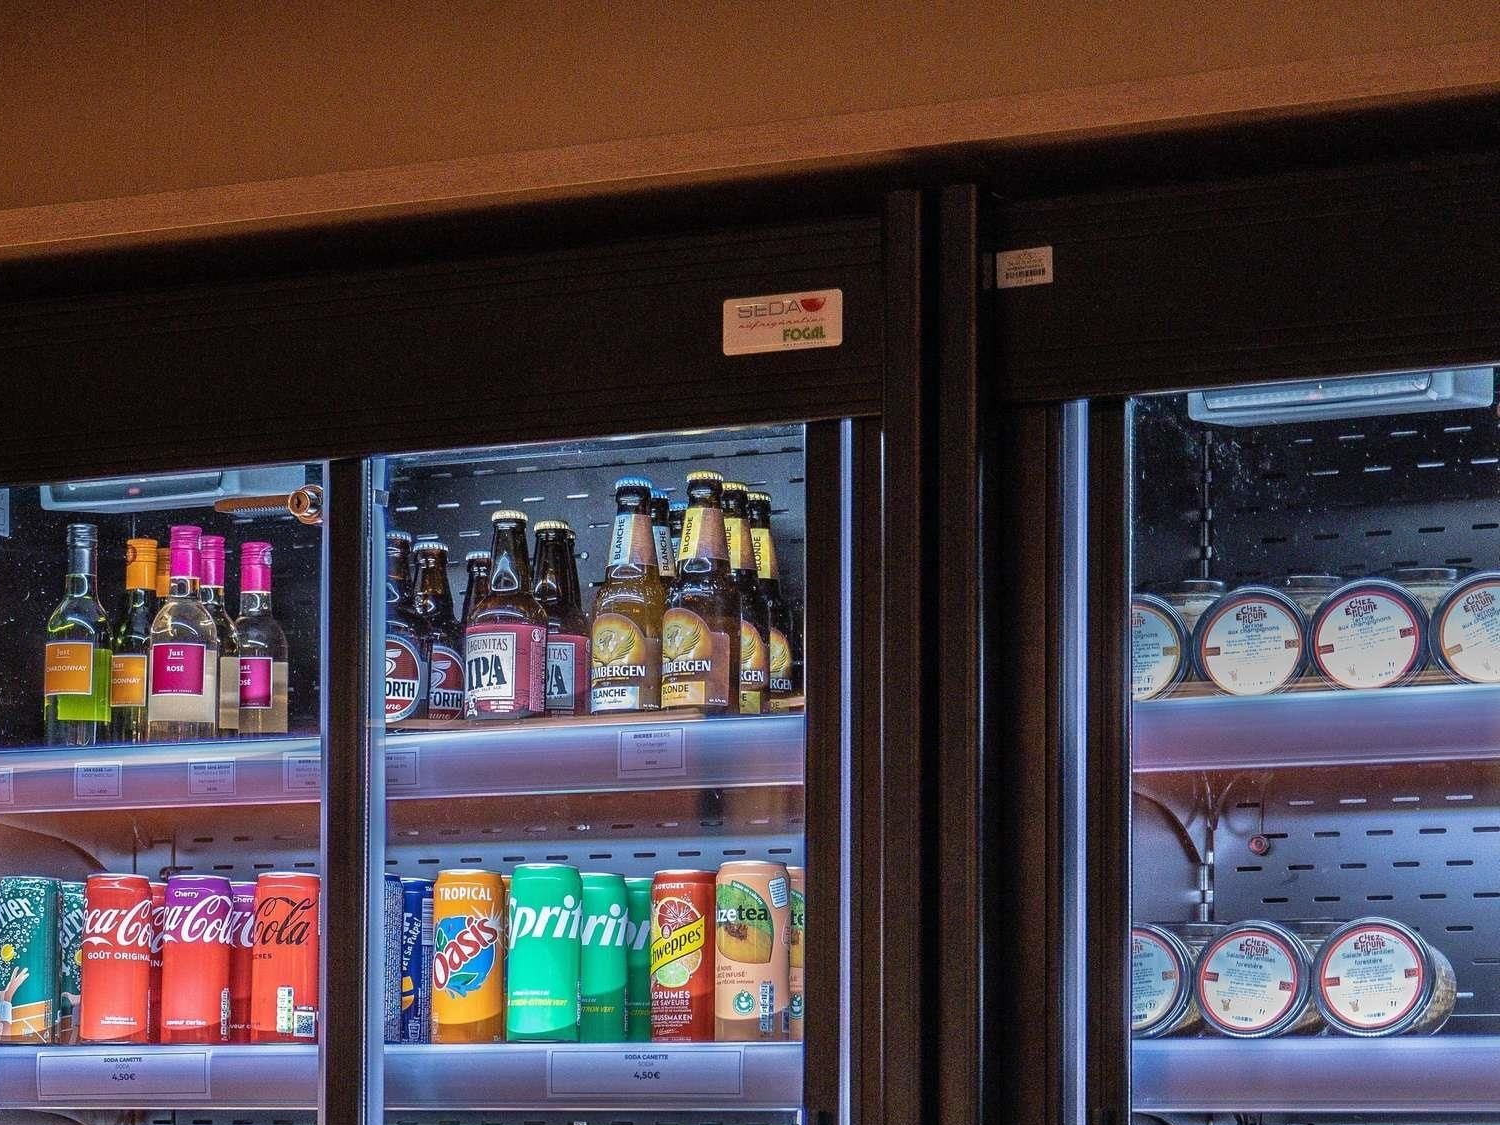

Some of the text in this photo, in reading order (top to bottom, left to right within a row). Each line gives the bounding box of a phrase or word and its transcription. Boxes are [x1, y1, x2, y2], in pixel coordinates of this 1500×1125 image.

[737, 300, 802, 319] SEDA
[614, 518, 625, 560] BLANCHE
[683, 516, 694, 553] BLONDE
[659, 531, 669, 571] BLANCHE
[166, 664, 185, 672] ROSÉ
[467, 653, 508, 692] IPA
[174, 890, 199, 899] Cherry
[439, 886, 493, 901] TROPICAL
[1245, 937, 1266, 947] CHEZ
[1358, 933, 1381, 944] CHEZ
[87, 951, 111, 960] GOÛT
[434, 916, 498, 990] Oasis
[112, 1073, 137, 1082] 4,50€
[633, 1071, 661, 1080] 4,50€
